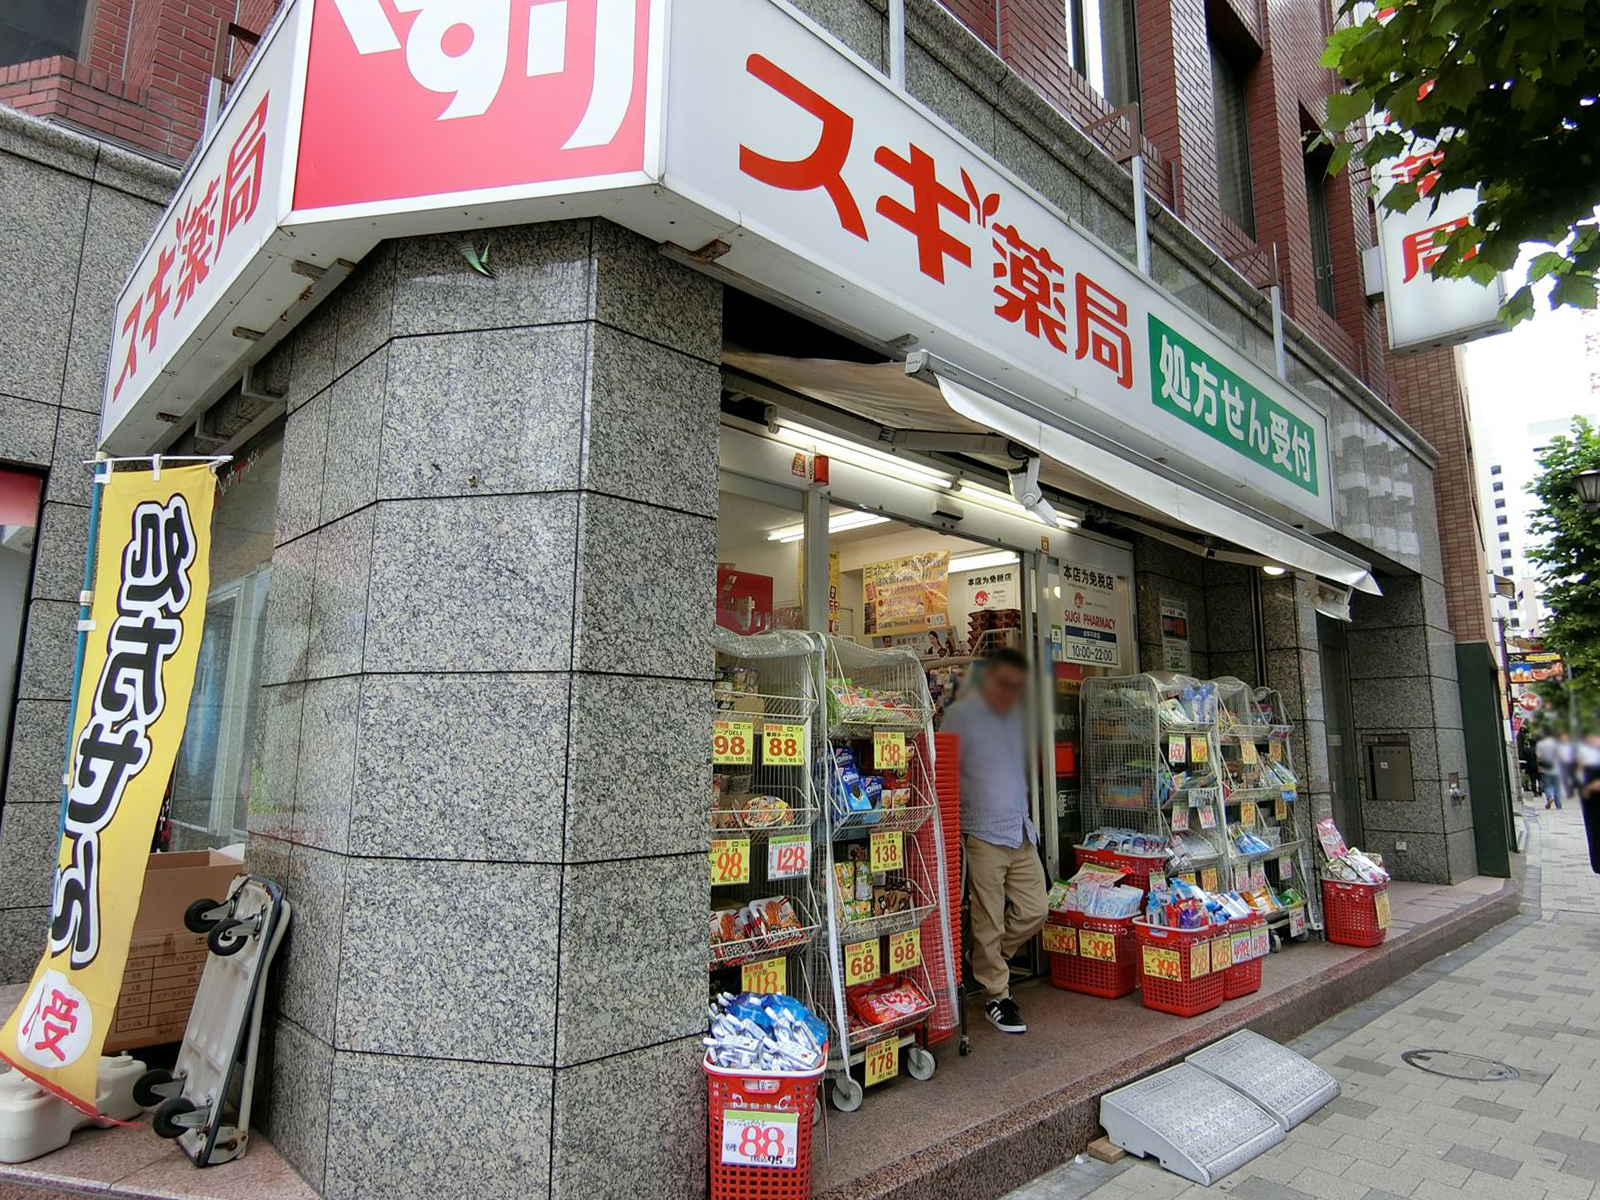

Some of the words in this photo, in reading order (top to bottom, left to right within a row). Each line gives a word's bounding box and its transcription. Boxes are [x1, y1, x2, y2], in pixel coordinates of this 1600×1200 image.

[739, 53, 1133, 390] スギ薬局
[112, 88, 271, 404] スギ薬局
[1159, 334, 1311, 483] 処方せん受付
[1063, 564, 1114, 591] 本店为免税店
[1064, 609, 1081, 624] SUGI
[1083, 613, 1116, 630] PHARMACY
[713, 735, 745, 756] 98
[769, 737, 797, 757] 88
[717, 852, 743, 880] 98
[777, 846, 806, 872] 128
[875, 844, 897, 863] 138
[851, 954, 875, 976] 68
[894, 942, 915, 964] 98
[869, 1051, 893, 1076] 178
[738, 1126, 785, 1157] 88
